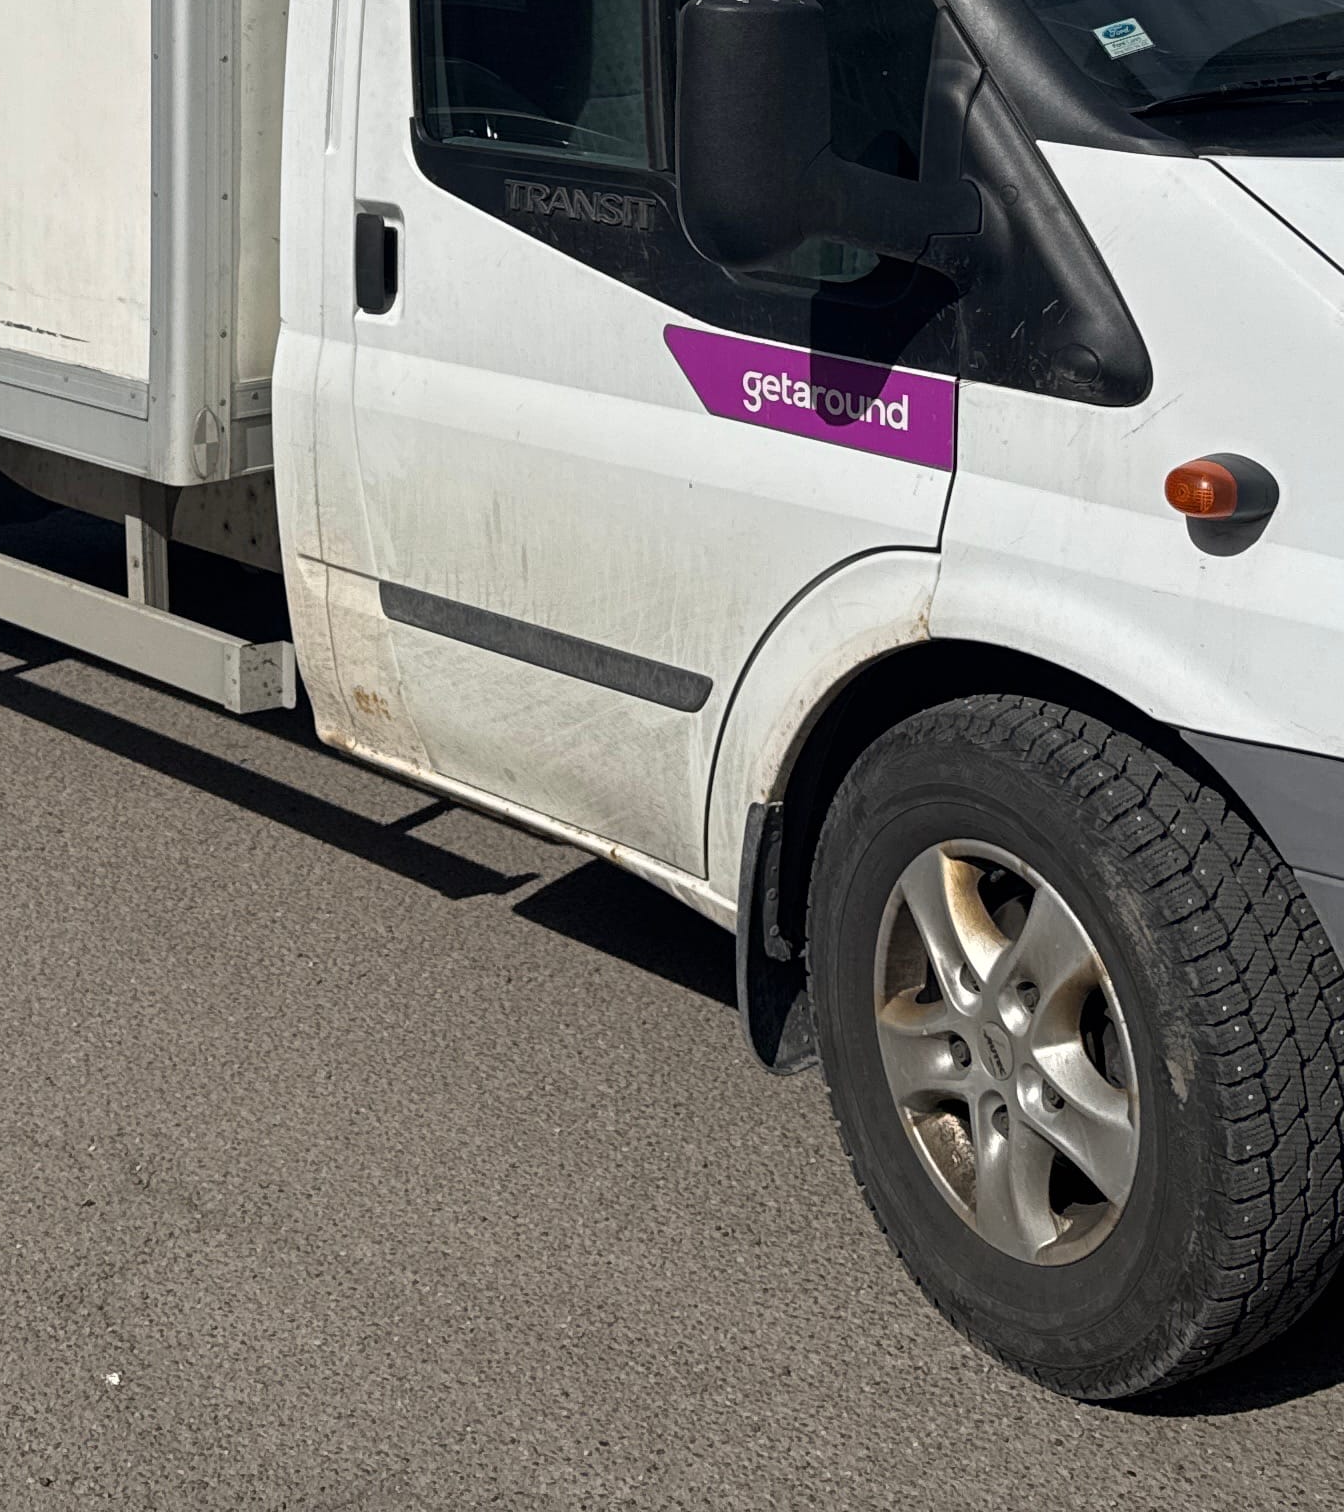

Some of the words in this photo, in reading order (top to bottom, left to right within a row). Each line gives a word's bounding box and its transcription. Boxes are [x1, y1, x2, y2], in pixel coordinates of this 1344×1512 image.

[1109, 25, 1129, 37] Ford
[504, 178, 656, 231] TRANSIT
[742, 369, 909, 431] getaround
